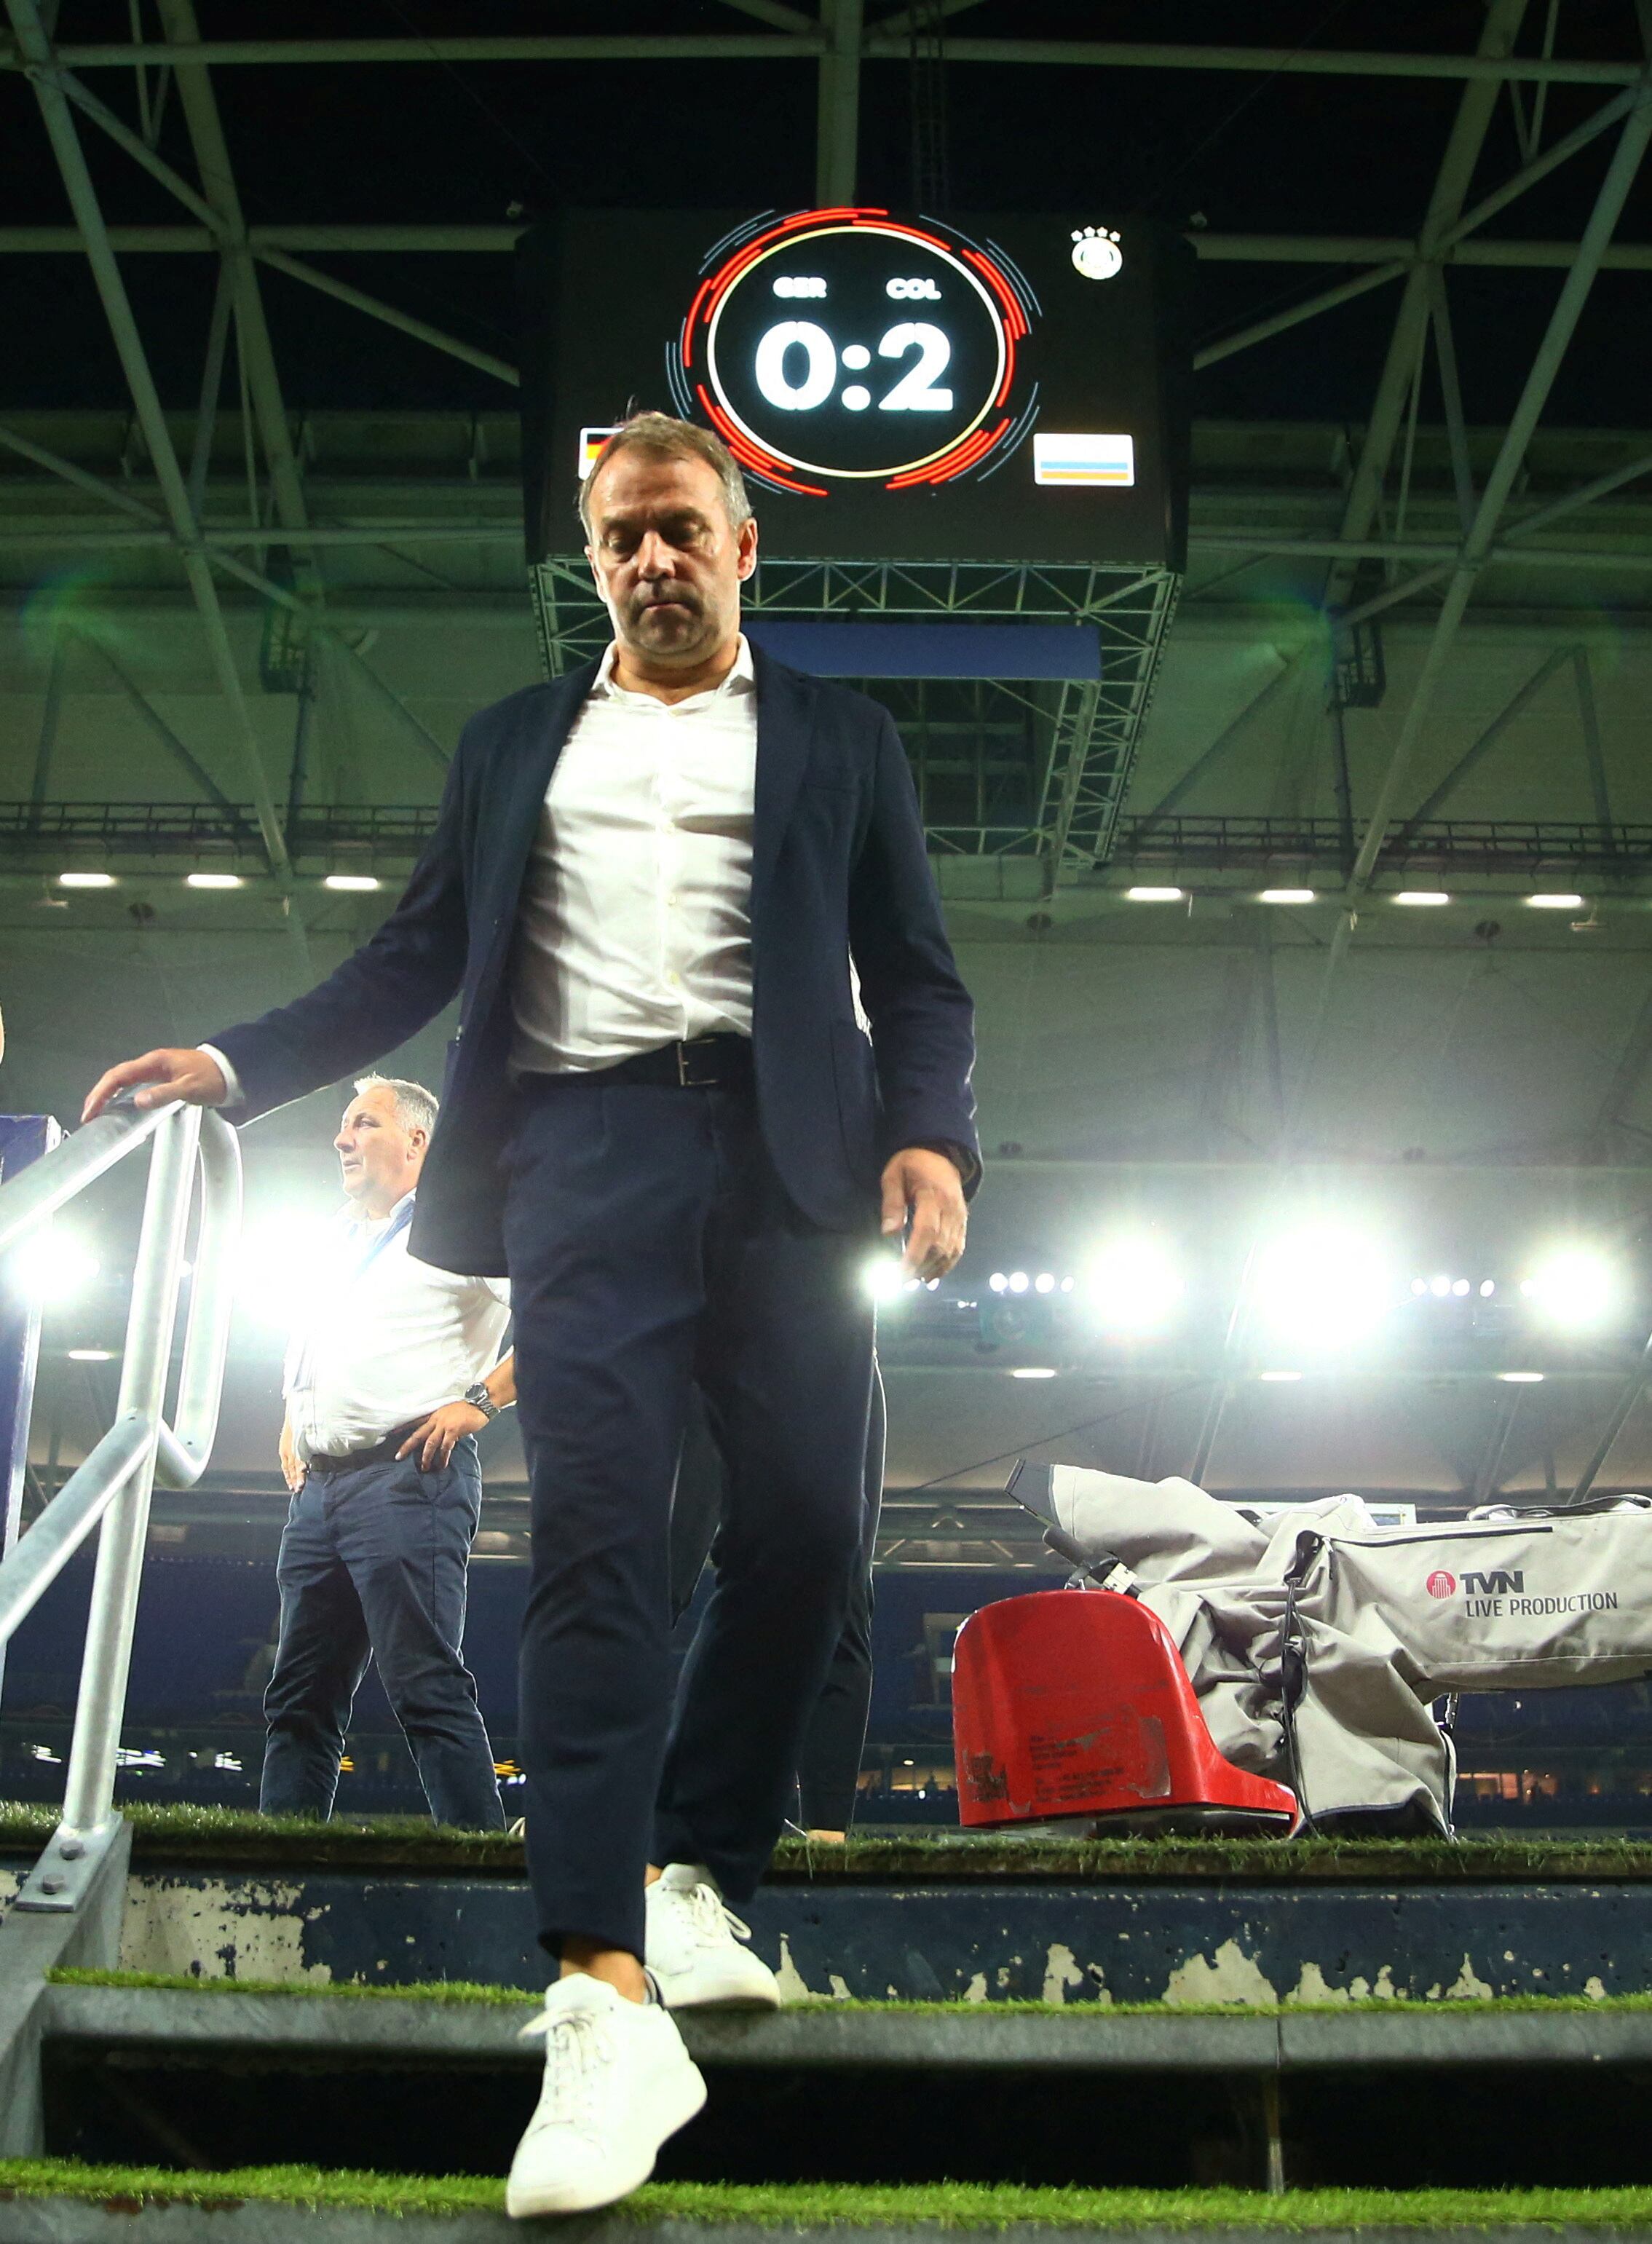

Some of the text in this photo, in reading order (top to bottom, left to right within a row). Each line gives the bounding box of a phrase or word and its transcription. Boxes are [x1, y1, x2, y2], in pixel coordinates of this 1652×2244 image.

[886, 278, 941, 300] COL
[755, 321, 954, 411] 0:2
[1460, 1571, 1525, 1595] TVN
[1466, 1592, 1619, 1618] LIVE PRODUCTION
